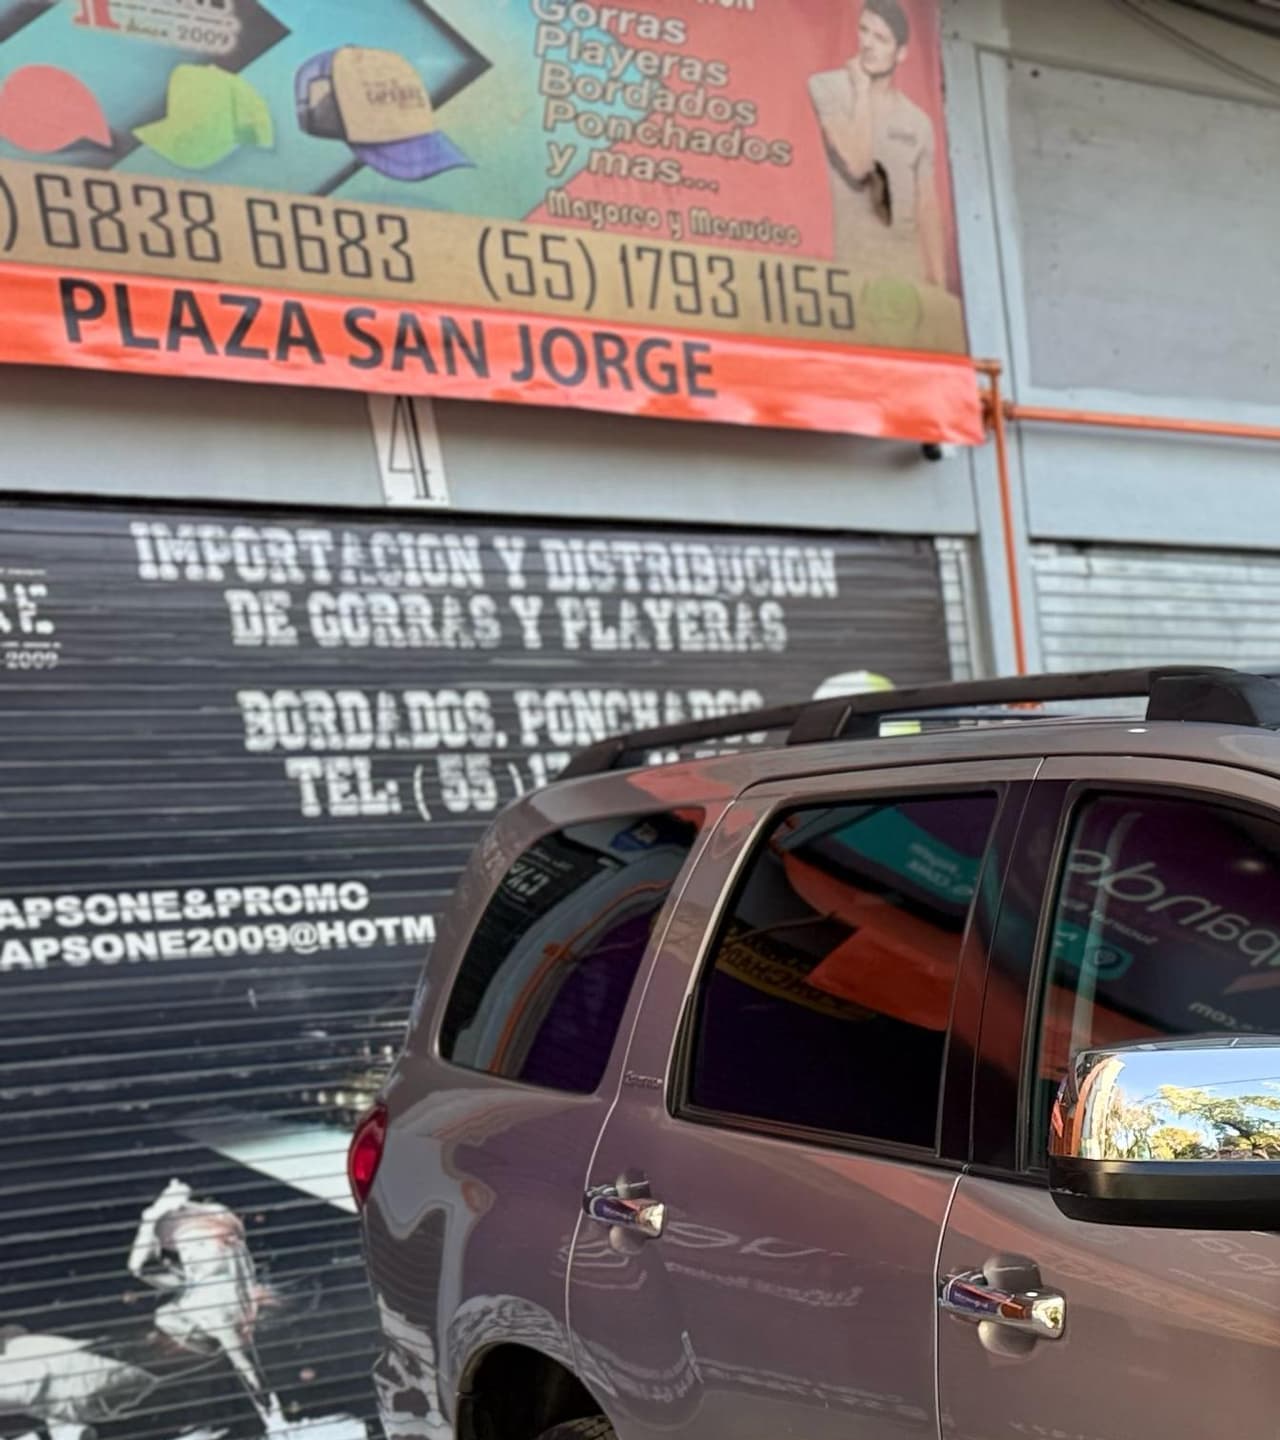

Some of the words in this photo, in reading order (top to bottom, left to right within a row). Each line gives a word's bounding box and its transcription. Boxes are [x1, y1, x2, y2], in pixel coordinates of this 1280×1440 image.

[177, 24, 229, 46] 2009
[532, 0, 688, 45] Gorras
[534, 25, 729, 87] Playeras
[539, 62, 758, 126] Bordados
[543, 99, 794, 166] Ponchados
[547, 141, 577, 178] y
[588, 145, 719, 194] mas...
[34, 172, 222, 264] 6838
[246, 197, 415, 283] 6683
[477, 225, 597, 312] (55)
[619, 243, 740, 320] 1793
[758, 260, 857, 331] 1155
[667, 209, 684, 239] y
[57, 276, 326, 365] PLAZA
[346, 304, 490, 379] SAN
[510, 323, 718, 398] JORGE
[388, 393, 435, 500] 4
[129, 521, 484, 589] IMPORTACION
[493, 535, 527, 590] Y
[539, 538, 839, 599] DISTRIBUCION
[224, 589, 299, 647] DE
[306, 590, 502, 650] GORRAS
[510, 595, 544, 650] Y
[555, 596, 788, 653] PLAYERAS
[4, 650, 60, 670] 2009
